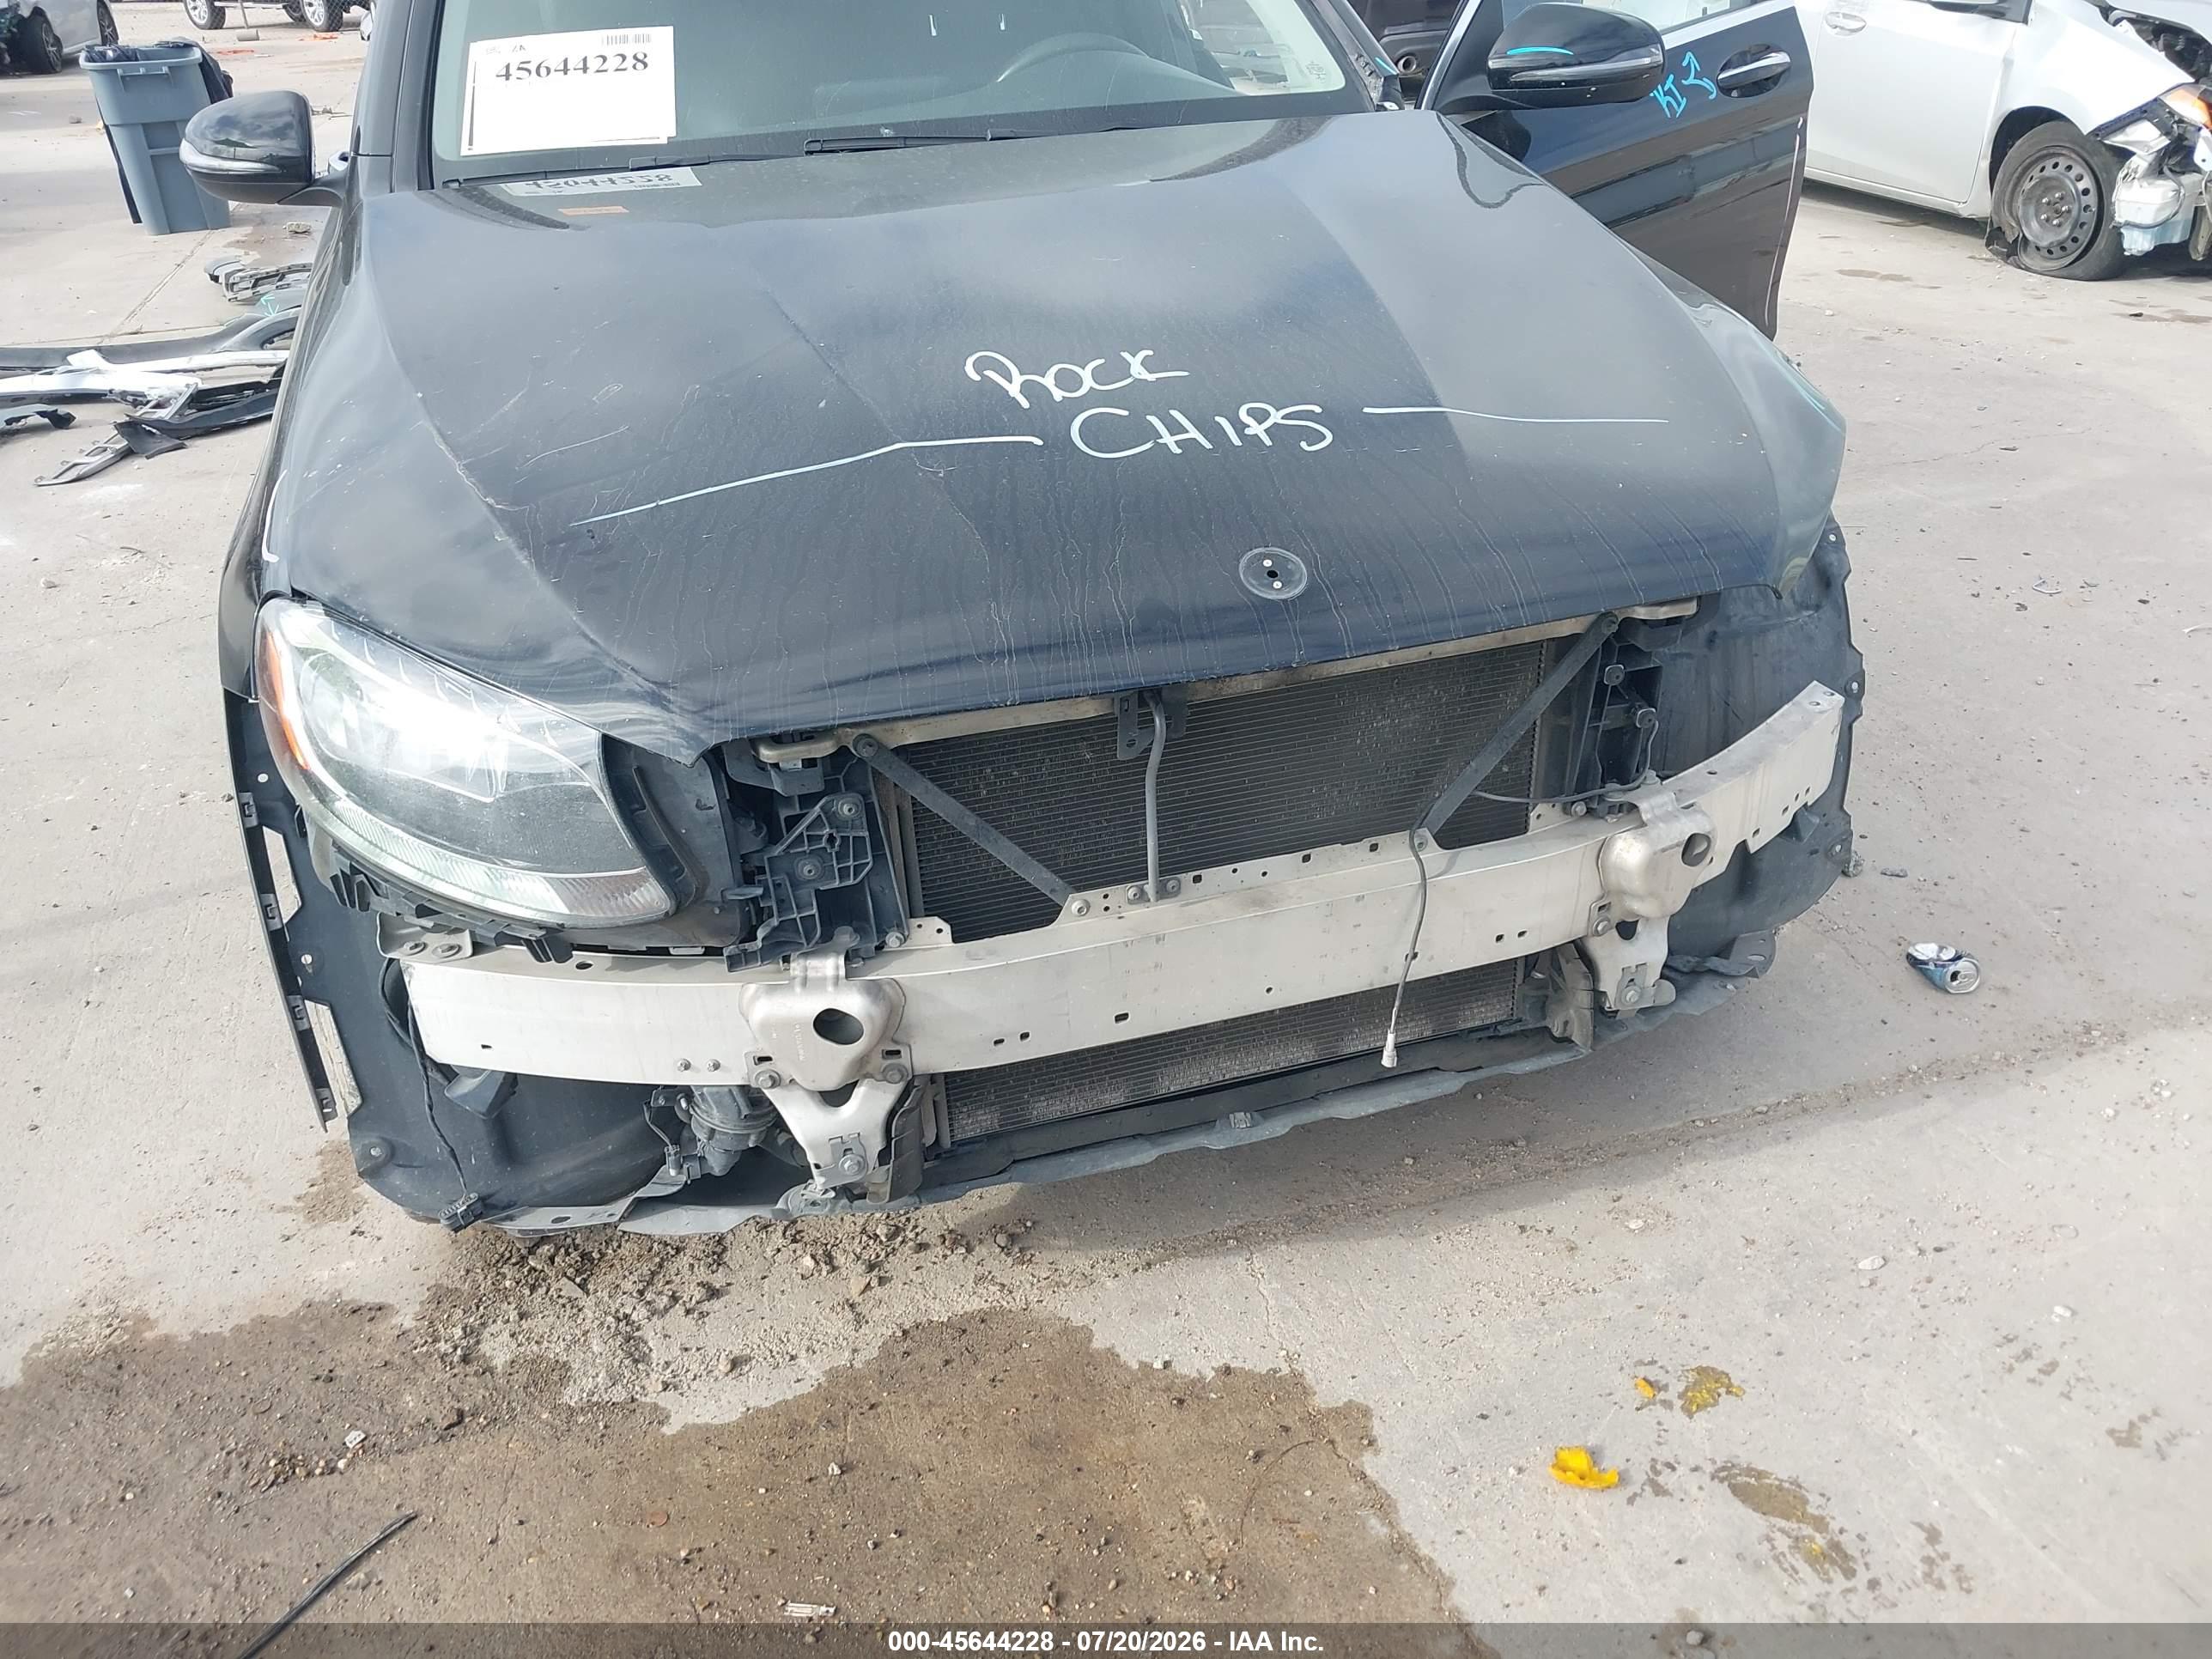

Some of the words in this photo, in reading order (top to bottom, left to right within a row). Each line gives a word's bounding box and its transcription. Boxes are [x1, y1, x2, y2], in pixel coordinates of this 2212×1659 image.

[495, 52, 649, 82] 45644228
[964, 350, 1190, 409] ROCK
[1070, 402, 1334, 459] CHIPS
